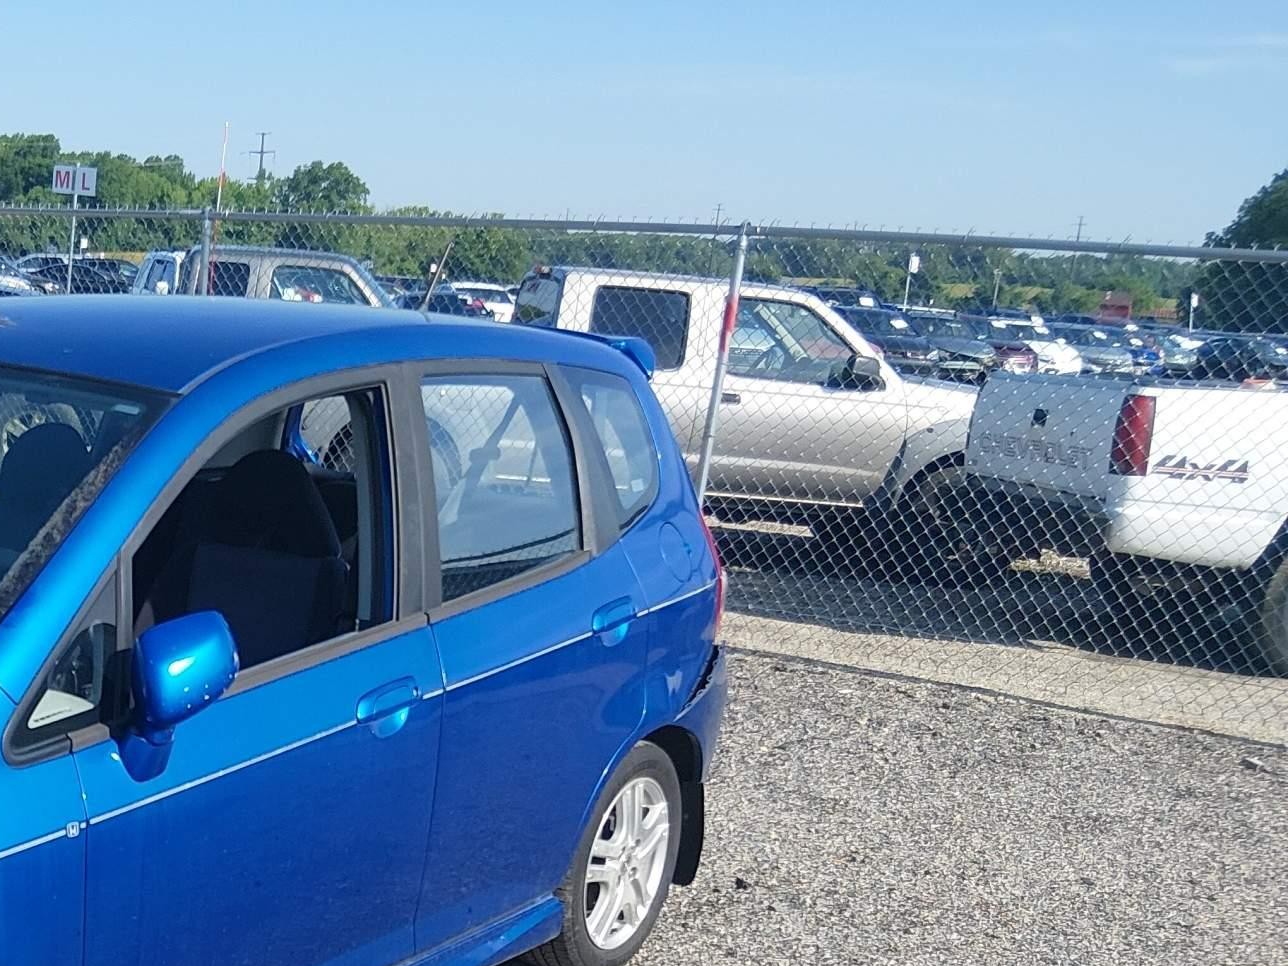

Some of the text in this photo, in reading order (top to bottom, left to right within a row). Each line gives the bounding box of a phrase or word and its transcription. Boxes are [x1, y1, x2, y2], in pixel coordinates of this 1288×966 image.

[55, 170, 91, 191] M L
[980, 431, 1093, 470] CHEVROLET
